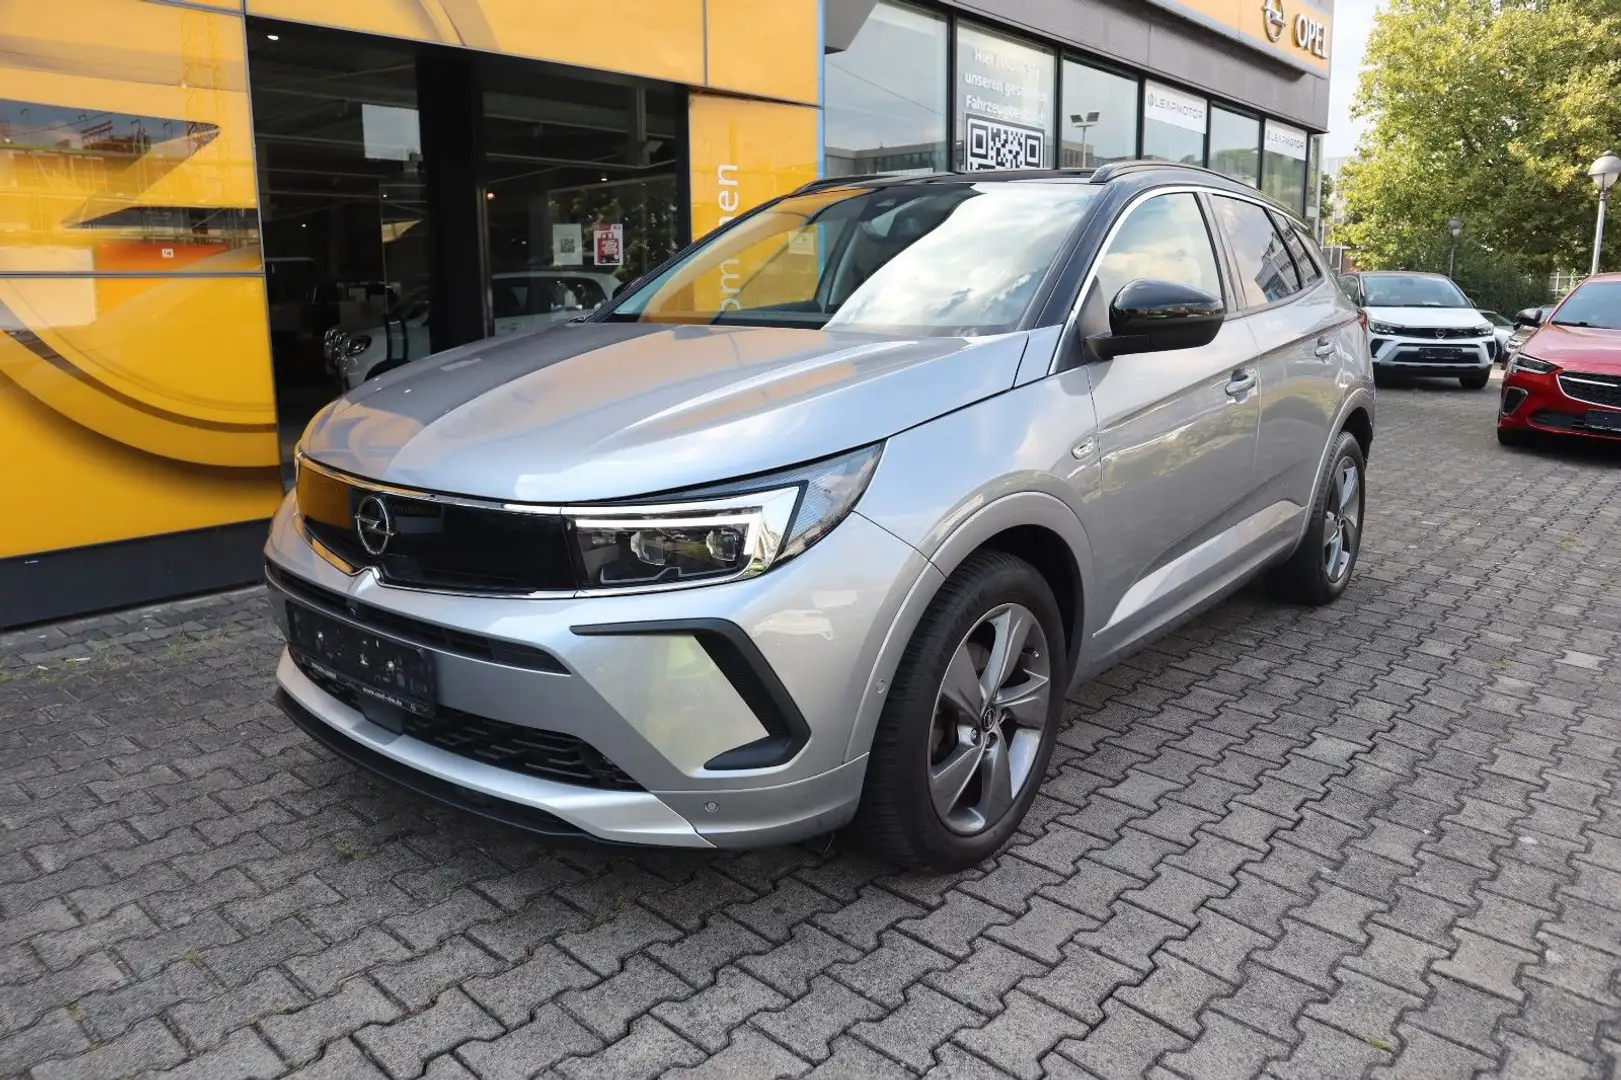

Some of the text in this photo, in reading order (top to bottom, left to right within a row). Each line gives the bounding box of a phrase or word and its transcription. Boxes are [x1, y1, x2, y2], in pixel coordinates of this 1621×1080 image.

[1294, 14, 1329, 58] OPEL
[965, 73, 1003, 92] unseren
[1155, 97, 1203, 119] LEAPMOTOR
